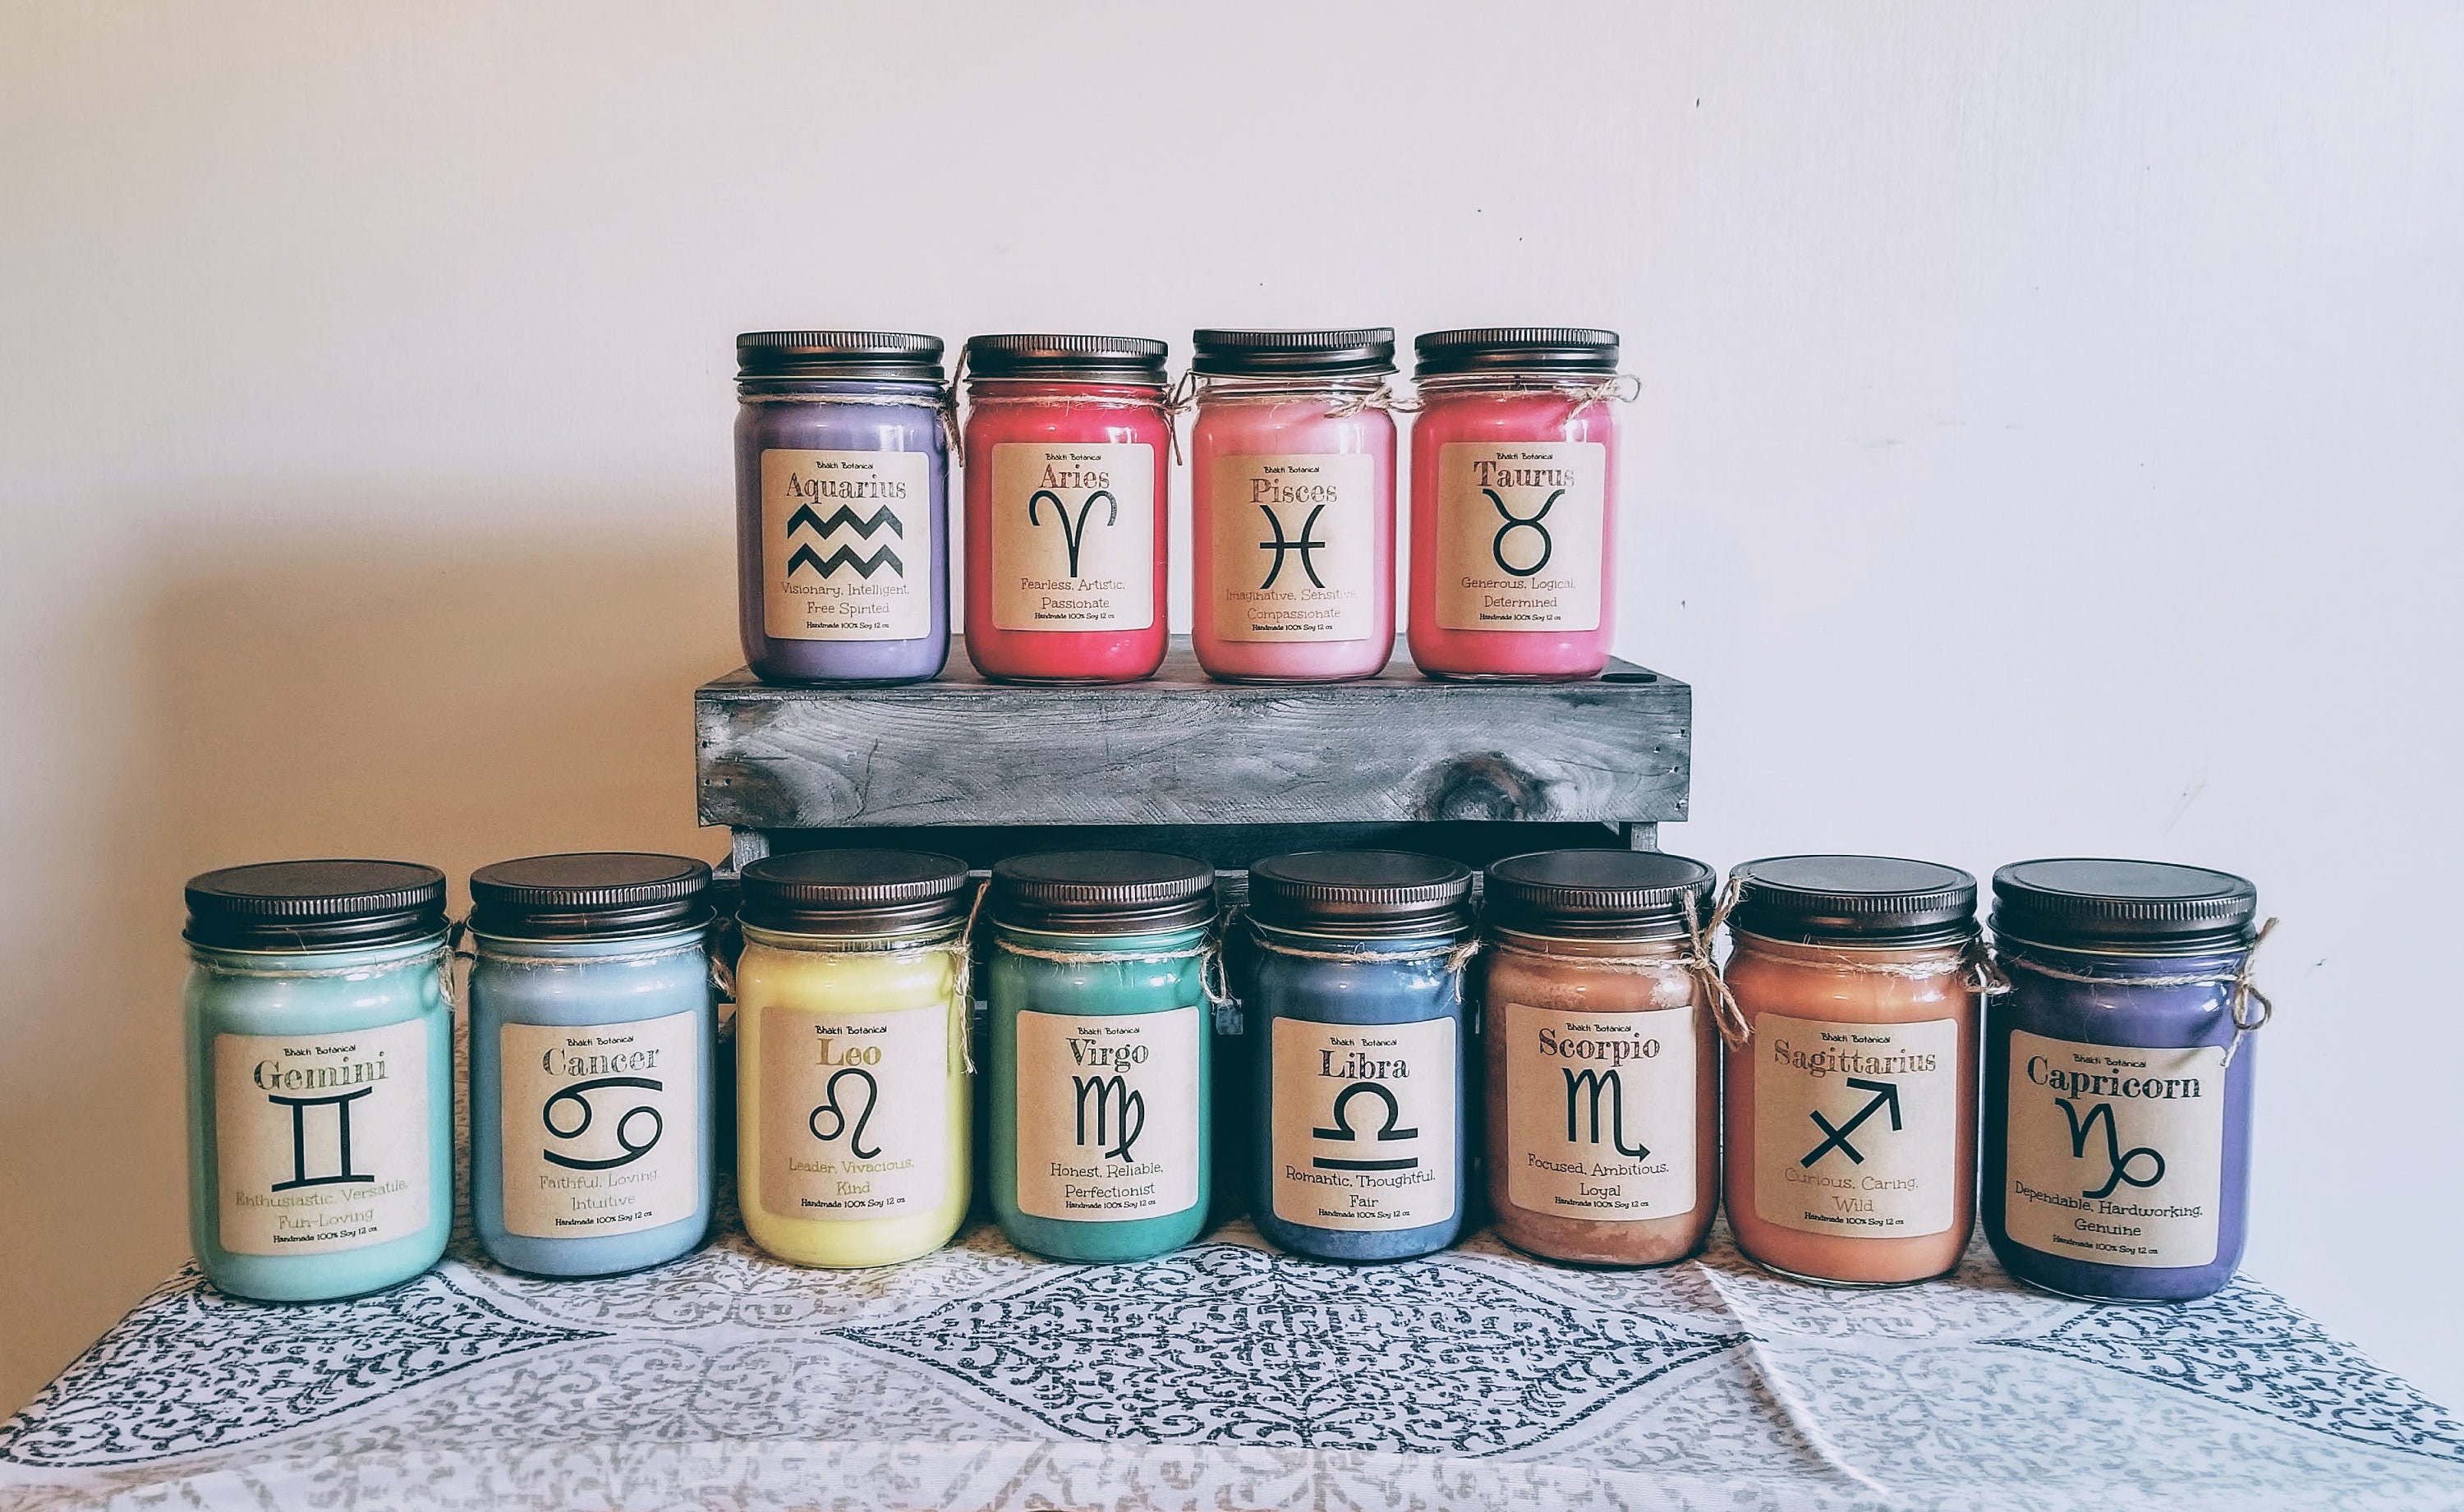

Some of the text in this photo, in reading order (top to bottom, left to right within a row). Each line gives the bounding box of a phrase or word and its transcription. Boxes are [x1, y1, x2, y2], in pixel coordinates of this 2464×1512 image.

[816, 461, 873, 470] Bhakti Botanical
[1038, 463, 1110, 489] Aries
[1474, 461, 1574, 487] Taurus
[787, 472, 906, 504] Aquarius
[1250, 478, 1337, 503] Pisces
[1041, 597, 1110, 609] Passionate
[1485, 595, 1557, 608] Determined
[807, 601, 890, 618] Free Spirited
[1248, 608, 1340, 623] Compassionate
[815, 1026, 886, 1035] Bhakti Botanical
[1566, 1023, 1631, 1032] Bhakti Botanical
[567, 1036, 633, 1046] Bhakti Botanical
[1330, 1037, 1354, 1046] Bhakti
[1821, 1032, 1890, 1043] Bhakti Botanical
[283, 1045, 356, 1056] Bhakti Botanical
[816, 1038, 881, 1066] Leo
[1538, 1028, 1660, 1067] Scorpio
[543, 1048, 659, 1076] Cancer
[1066, 1038, 1148, 1073] Virgo
[1775, 1039, 1936, 1078] Sagittarius
[2073, 1054, 2146, 1068] Bhakti Botanical
[254, 1051, 388, 1090] Gemini
[1318, 1049, 1409, 1079] Libra
[2028, 1056, 2202, 1100] Capricorn
[837, 1182, 871, 1196] Kind
[1065, 1184, 1155, 1197] Perfectionist
[1580, 1183, 1621, 1199] Loyal
[572, 1195, 635, 1211] Intuitive
[801, 1198, 842, 1207] Handmade
[868, 1199, 884, 1208] Soy
[1066, 1201, 1101, 1209] Handmade
[1349, 1195, 1379, 1207] Fair
[1555, 1197, 1592, 1206] Handmade
[1614, 1201, 1630, 1209] Soy
[1832, 1197, 1873, 1212] Wild
[278, 1209, 374, 1229] Fun-Loving
[1318, 1209, 1354, 1217] Handmade
[1804, 1212, 1844, 1223] Handmade
[555, 1218, 594, 1226] Handmade
[596, 1216, 616, 1224] 100%
[618, 1215, 632, 1223] Soy
[2075, 1219, 2142, 1236] Genuine
[274, 1235, 314, 1243] Handmade
[317, 1232, 338, 1240] 100%
[340, 1230, 356, 1239] Soy
[2053, 1235, 2093, 1248] Handmade
[2096, 1243, 2117, 1252] 100%
[2119, 1246, 2135, 1254] Soy
